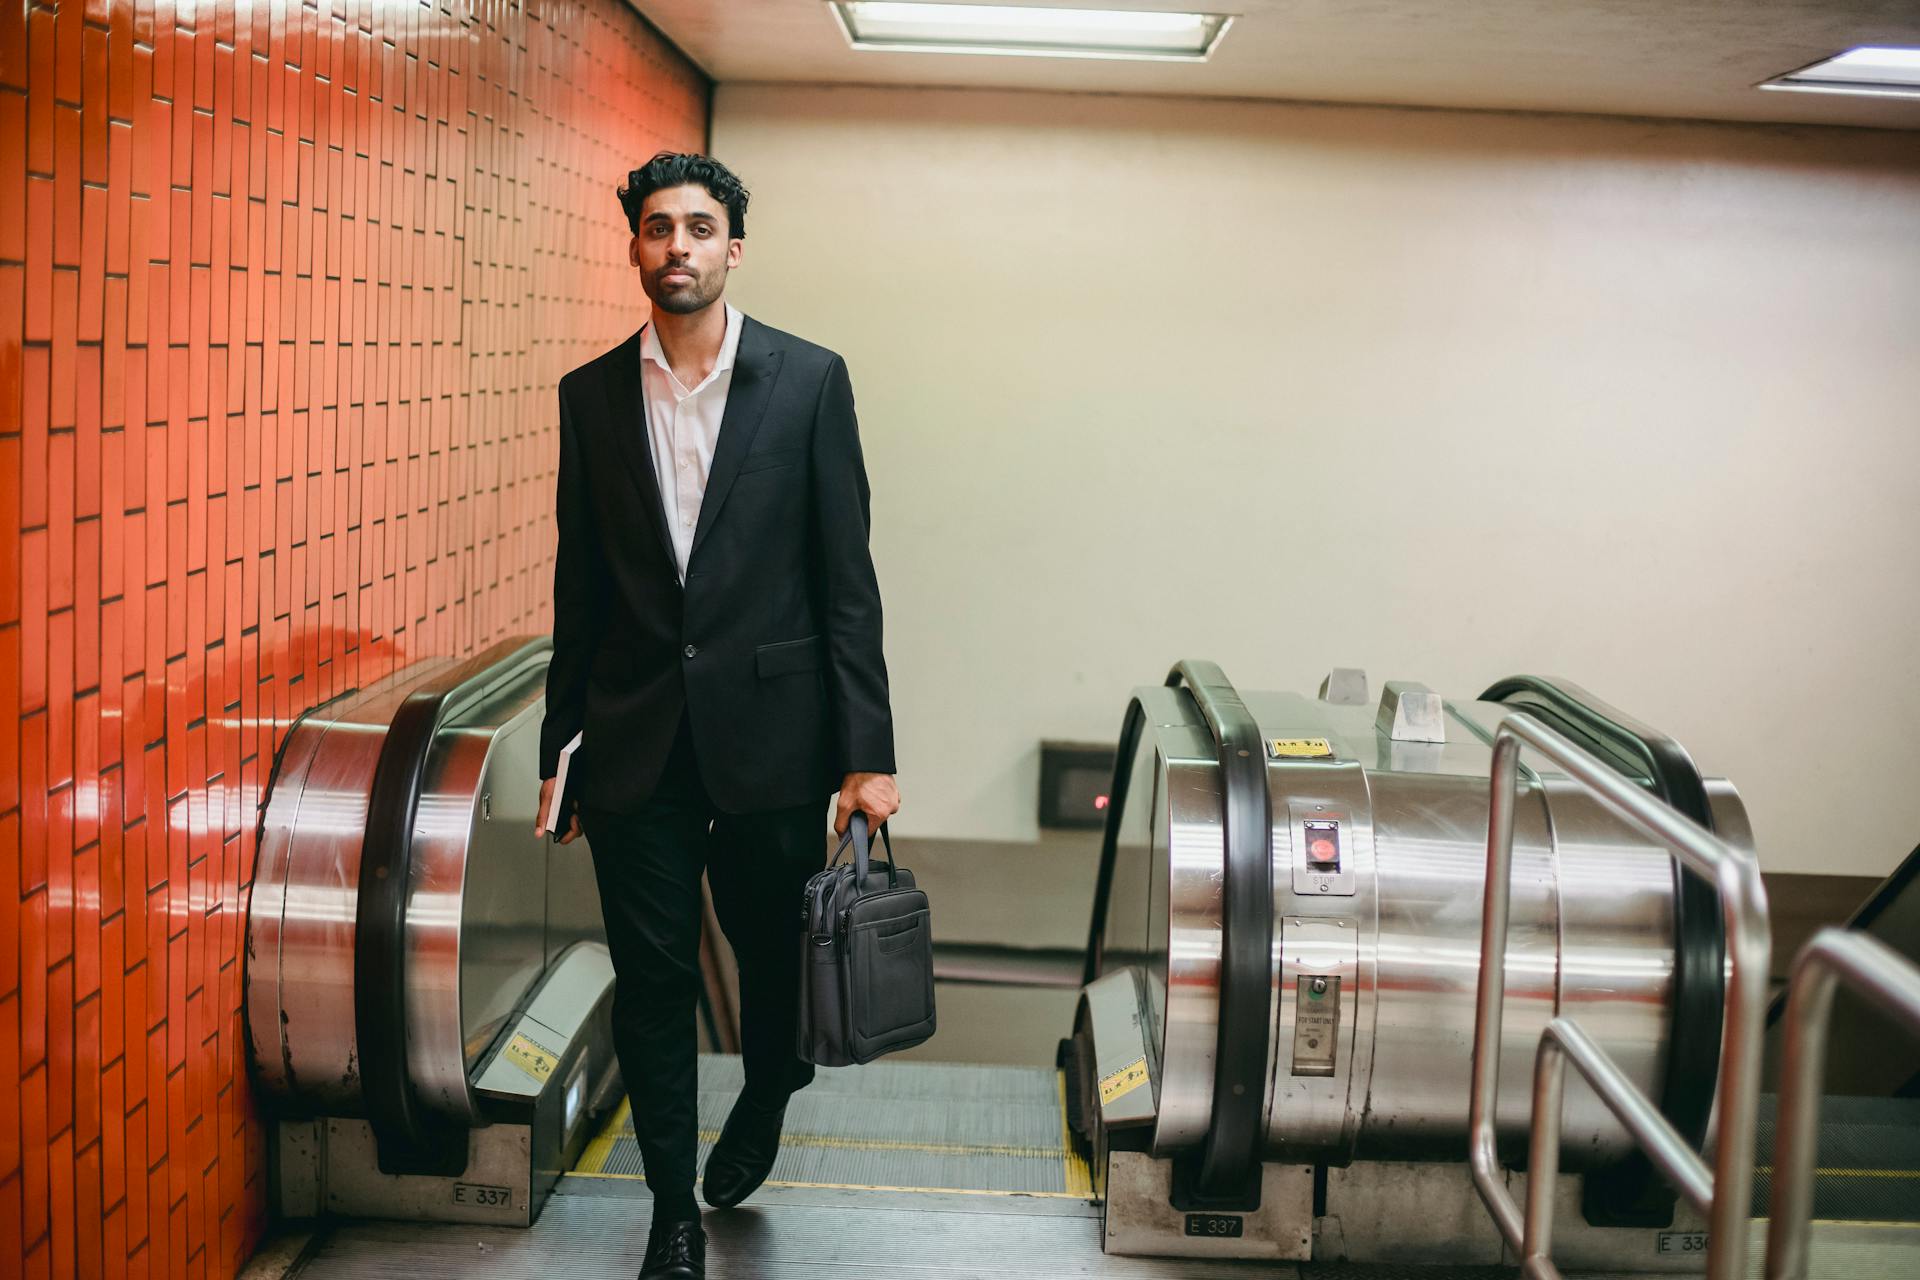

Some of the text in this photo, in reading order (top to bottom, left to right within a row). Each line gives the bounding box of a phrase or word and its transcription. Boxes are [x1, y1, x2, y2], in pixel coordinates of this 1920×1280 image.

[1312, 875, 1335, 885] STOP
[455, 1187, 509, 1206] E 337
[1191, 1219, 1237, 1234] E 337
[1661, 1237, 1672, 1251] E
